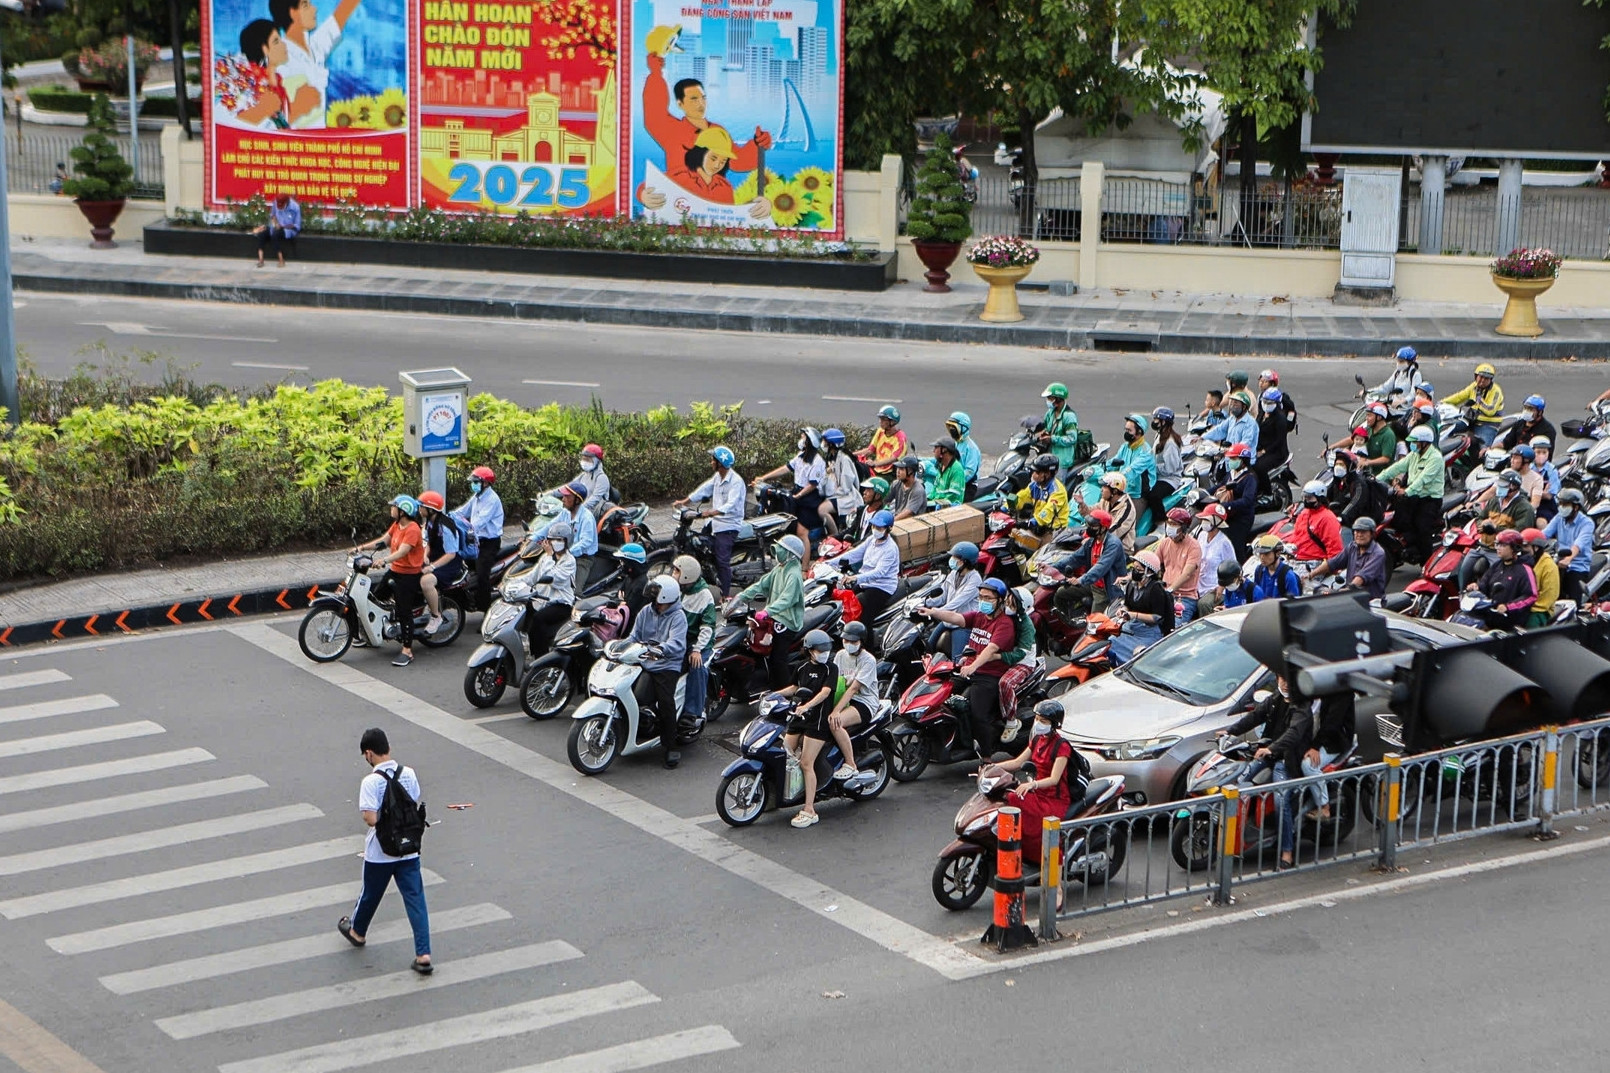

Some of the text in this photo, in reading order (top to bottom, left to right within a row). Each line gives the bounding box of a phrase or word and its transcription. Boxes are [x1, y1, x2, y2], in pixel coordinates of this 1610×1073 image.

[474, 3, 532, 24] HOAN
[773, 11, 792, 20] NAM
[424, 22, 530, 47] CHÀO ĐÓN
[426, 46, 522, 70] NĂM MỚI
[448, 163, 591, 208] 2025
